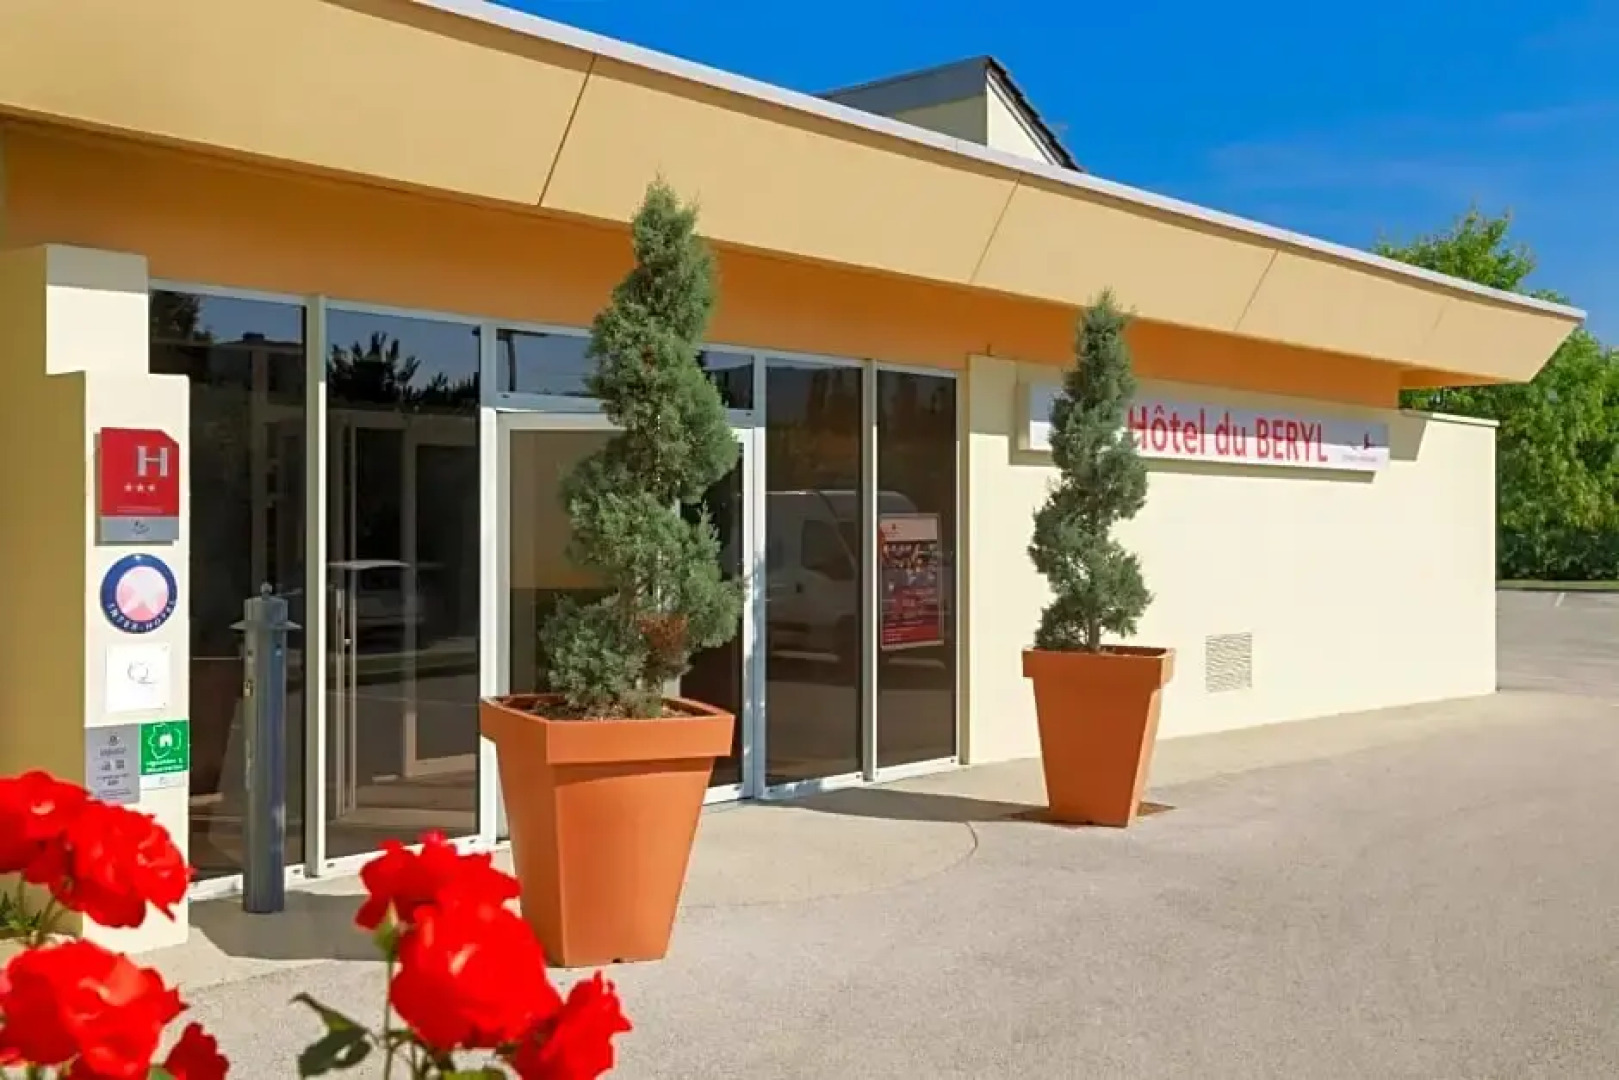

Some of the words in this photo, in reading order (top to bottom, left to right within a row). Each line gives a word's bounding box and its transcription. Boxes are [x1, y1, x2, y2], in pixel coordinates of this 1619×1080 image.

[1128, 404, 1204, 455] Hôtel
[1215, 411, 1246, 456] du
[1256, 417, 1328, 462] BERYL
[137, 445, 168, 477] H
